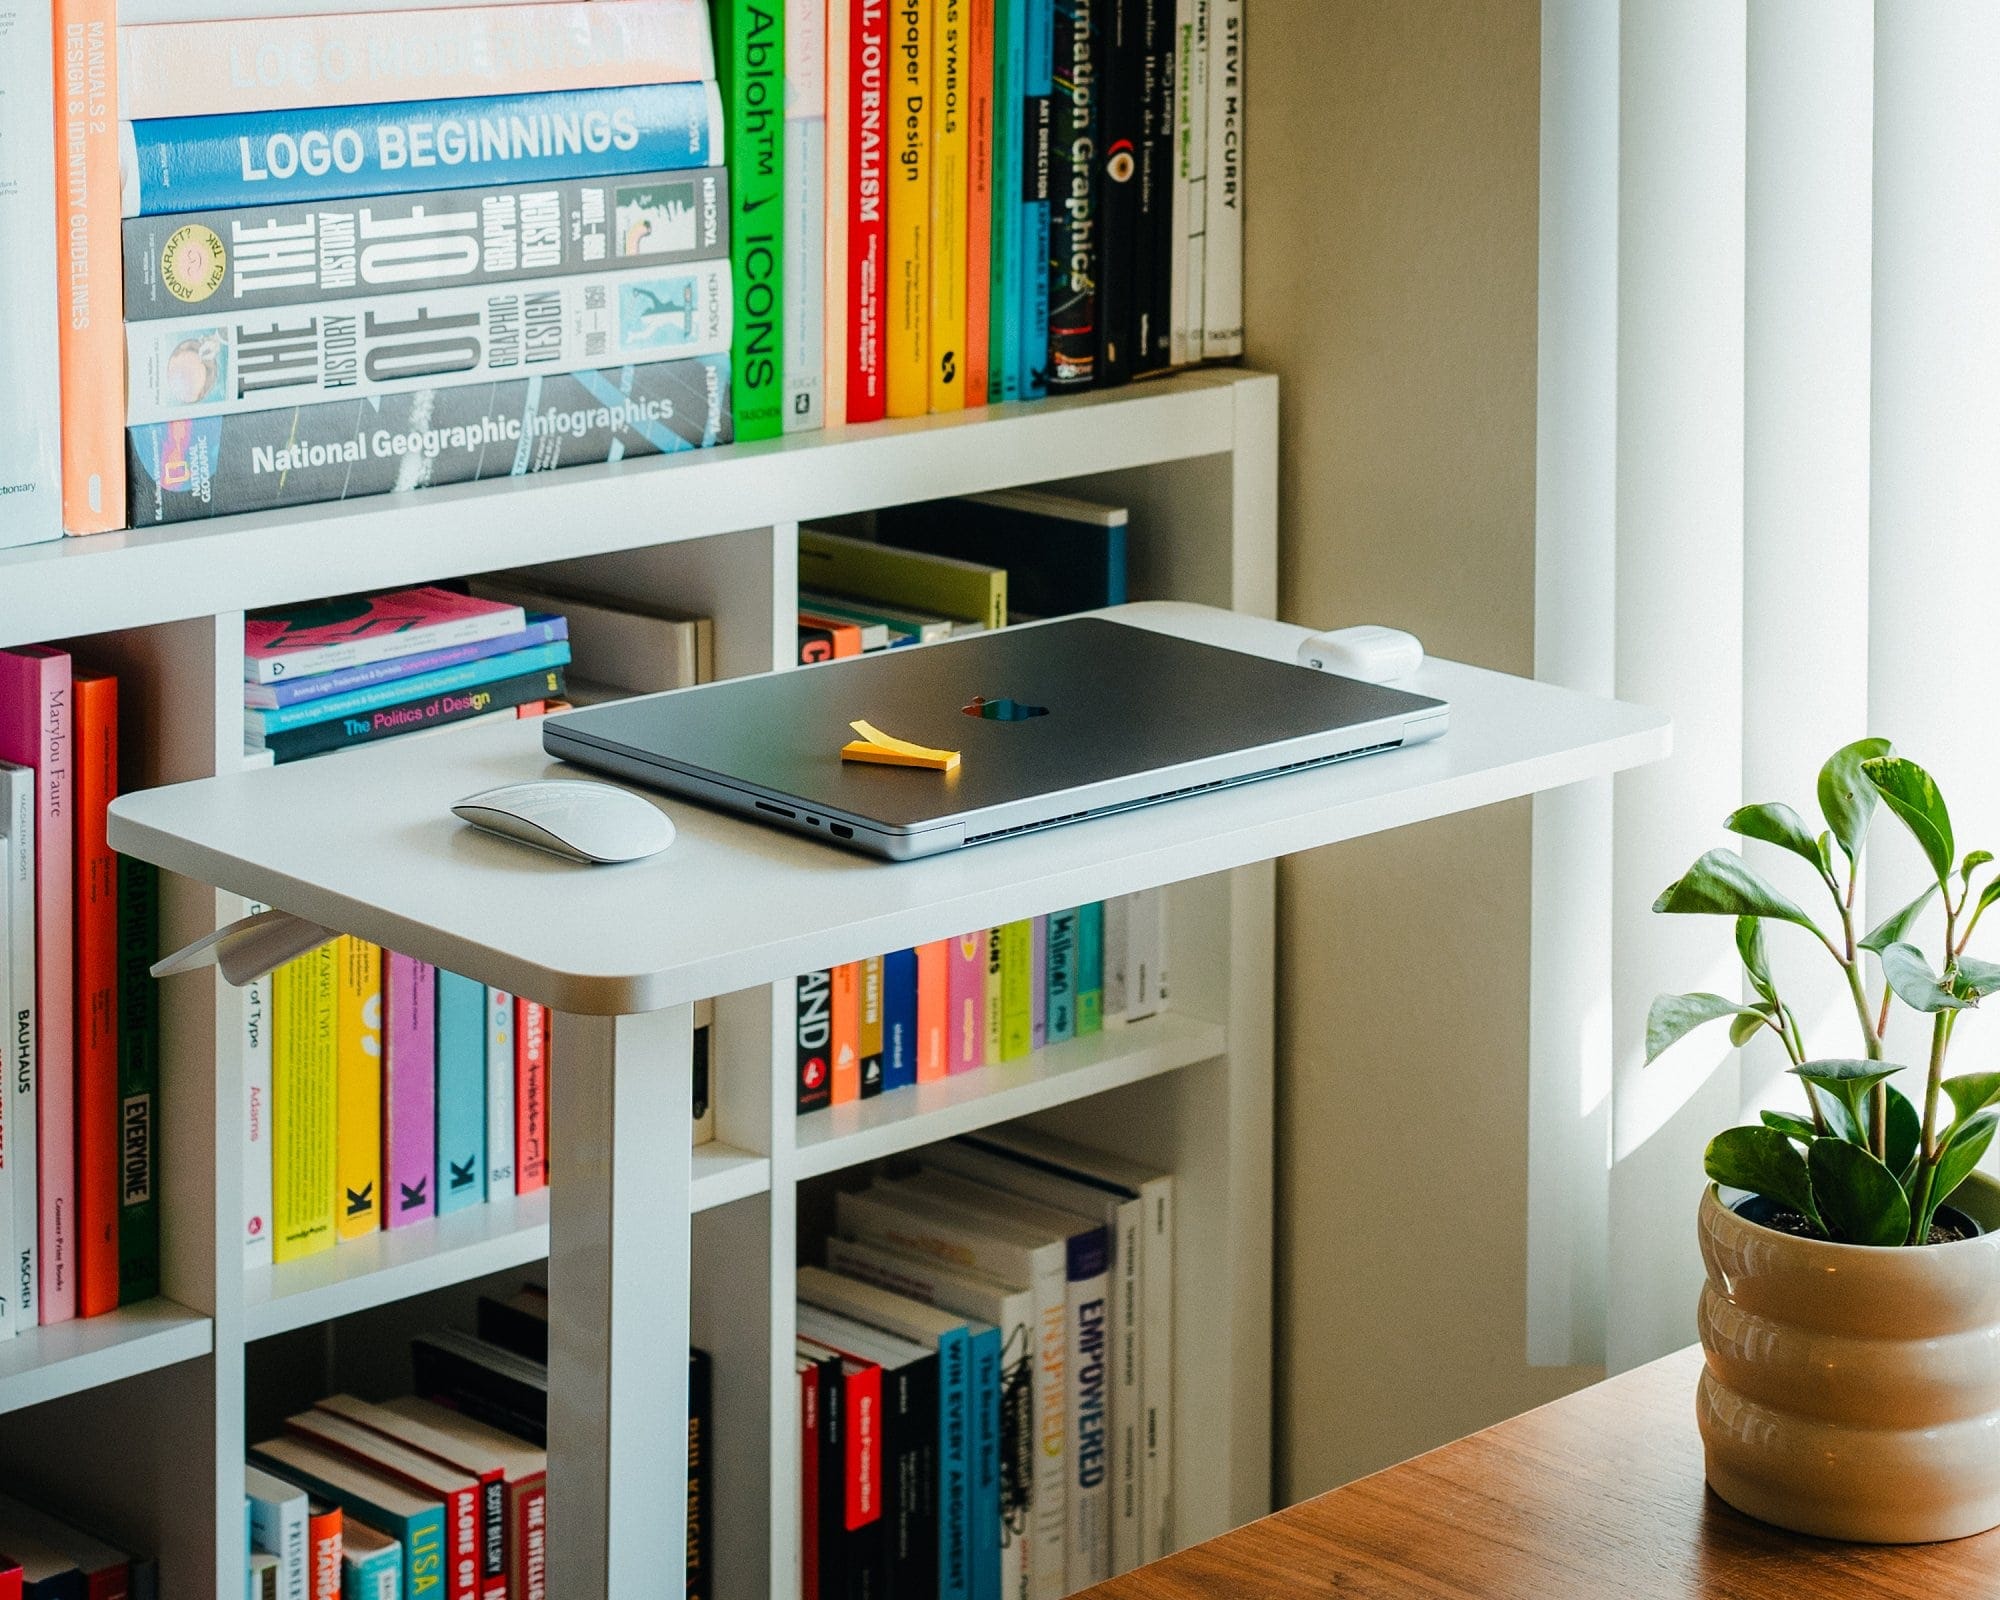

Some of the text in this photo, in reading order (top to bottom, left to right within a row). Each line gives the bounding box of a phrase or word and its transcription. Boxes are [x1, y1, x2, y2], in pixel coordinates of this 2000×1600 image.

[88, 21, 106, 135] MANUALS 2
[229, 37, 352, 90] LOGO
[945, 29, 958, 134] SYMBOLS
[239, 128, 365, 181] LOGO
[378, 108, 640, 170] BEGINNINGS
[860, 32, 882, 223] JOURNALISM
[901, 96, 923, 182] Design
[1039, 99, 1050, 123] ART
[1224, 18, 1238, 210] STEVE McCURRY
[67, 23, 90, 330] DESIGN & IDENTITY GUIDELINES
[1037, 127, 1050, 199] DIRECTION
[319, 211, 357, 290] HISTORY
[359, 205, 480, 284] OF
[482, 194, 518, 273] GRAPHIC
[519, 190, 562, 269] DESIGN
[703, 177, 718, 248] TASCHEN
[1065, 136, 1095, 293] Graphics
[162, 226, 193, 299] ATOMKRAFT?
[205, 232, 225, 290] NEJ TAK
[232, 213, 318, 298] THE
[487, 294, 519, 368] GRAPHIC
[524, 289, 562, 364] DESIGN
[709, 272, 719, 341] TASCHEN
[745, 234, 774, 389] ICONS
[236, 317, 319, 400] THE
[322, 315, 357, 389] HISTORY
[364, 306, 482, 384] OF
[705, 364, 721, 434] TASCHEN
[190, 443, 201, 497] NATIONAL
[198, 434, 211, 503] GEOGRAPHIC
[251, 432, 367, 474] National
[373, 415, 521, 459] Geographic
[344, 691, 491, 736] The Politics of Design
[45, 690, 65, 818] Marylou Faure
[18, 1009, 31, 1094] BAUHAUS
[248, 989, 261, 1048] of Type
[126, 1101, 147, 1200] EVERYONE
[250, 1085, 262, 1143] Adams
[21, 1248, 31, 1309] TASCHEN
[1078, 1298, 1105, 1489] EMPOWERED
[457, 1493, 475, 1581] ALONE ON
[485, 1483, 503, 1573] SCOTT BELSKY
[528, 1496, 545, 1529] THE
[411, 1524, 441, 1595] LISA
